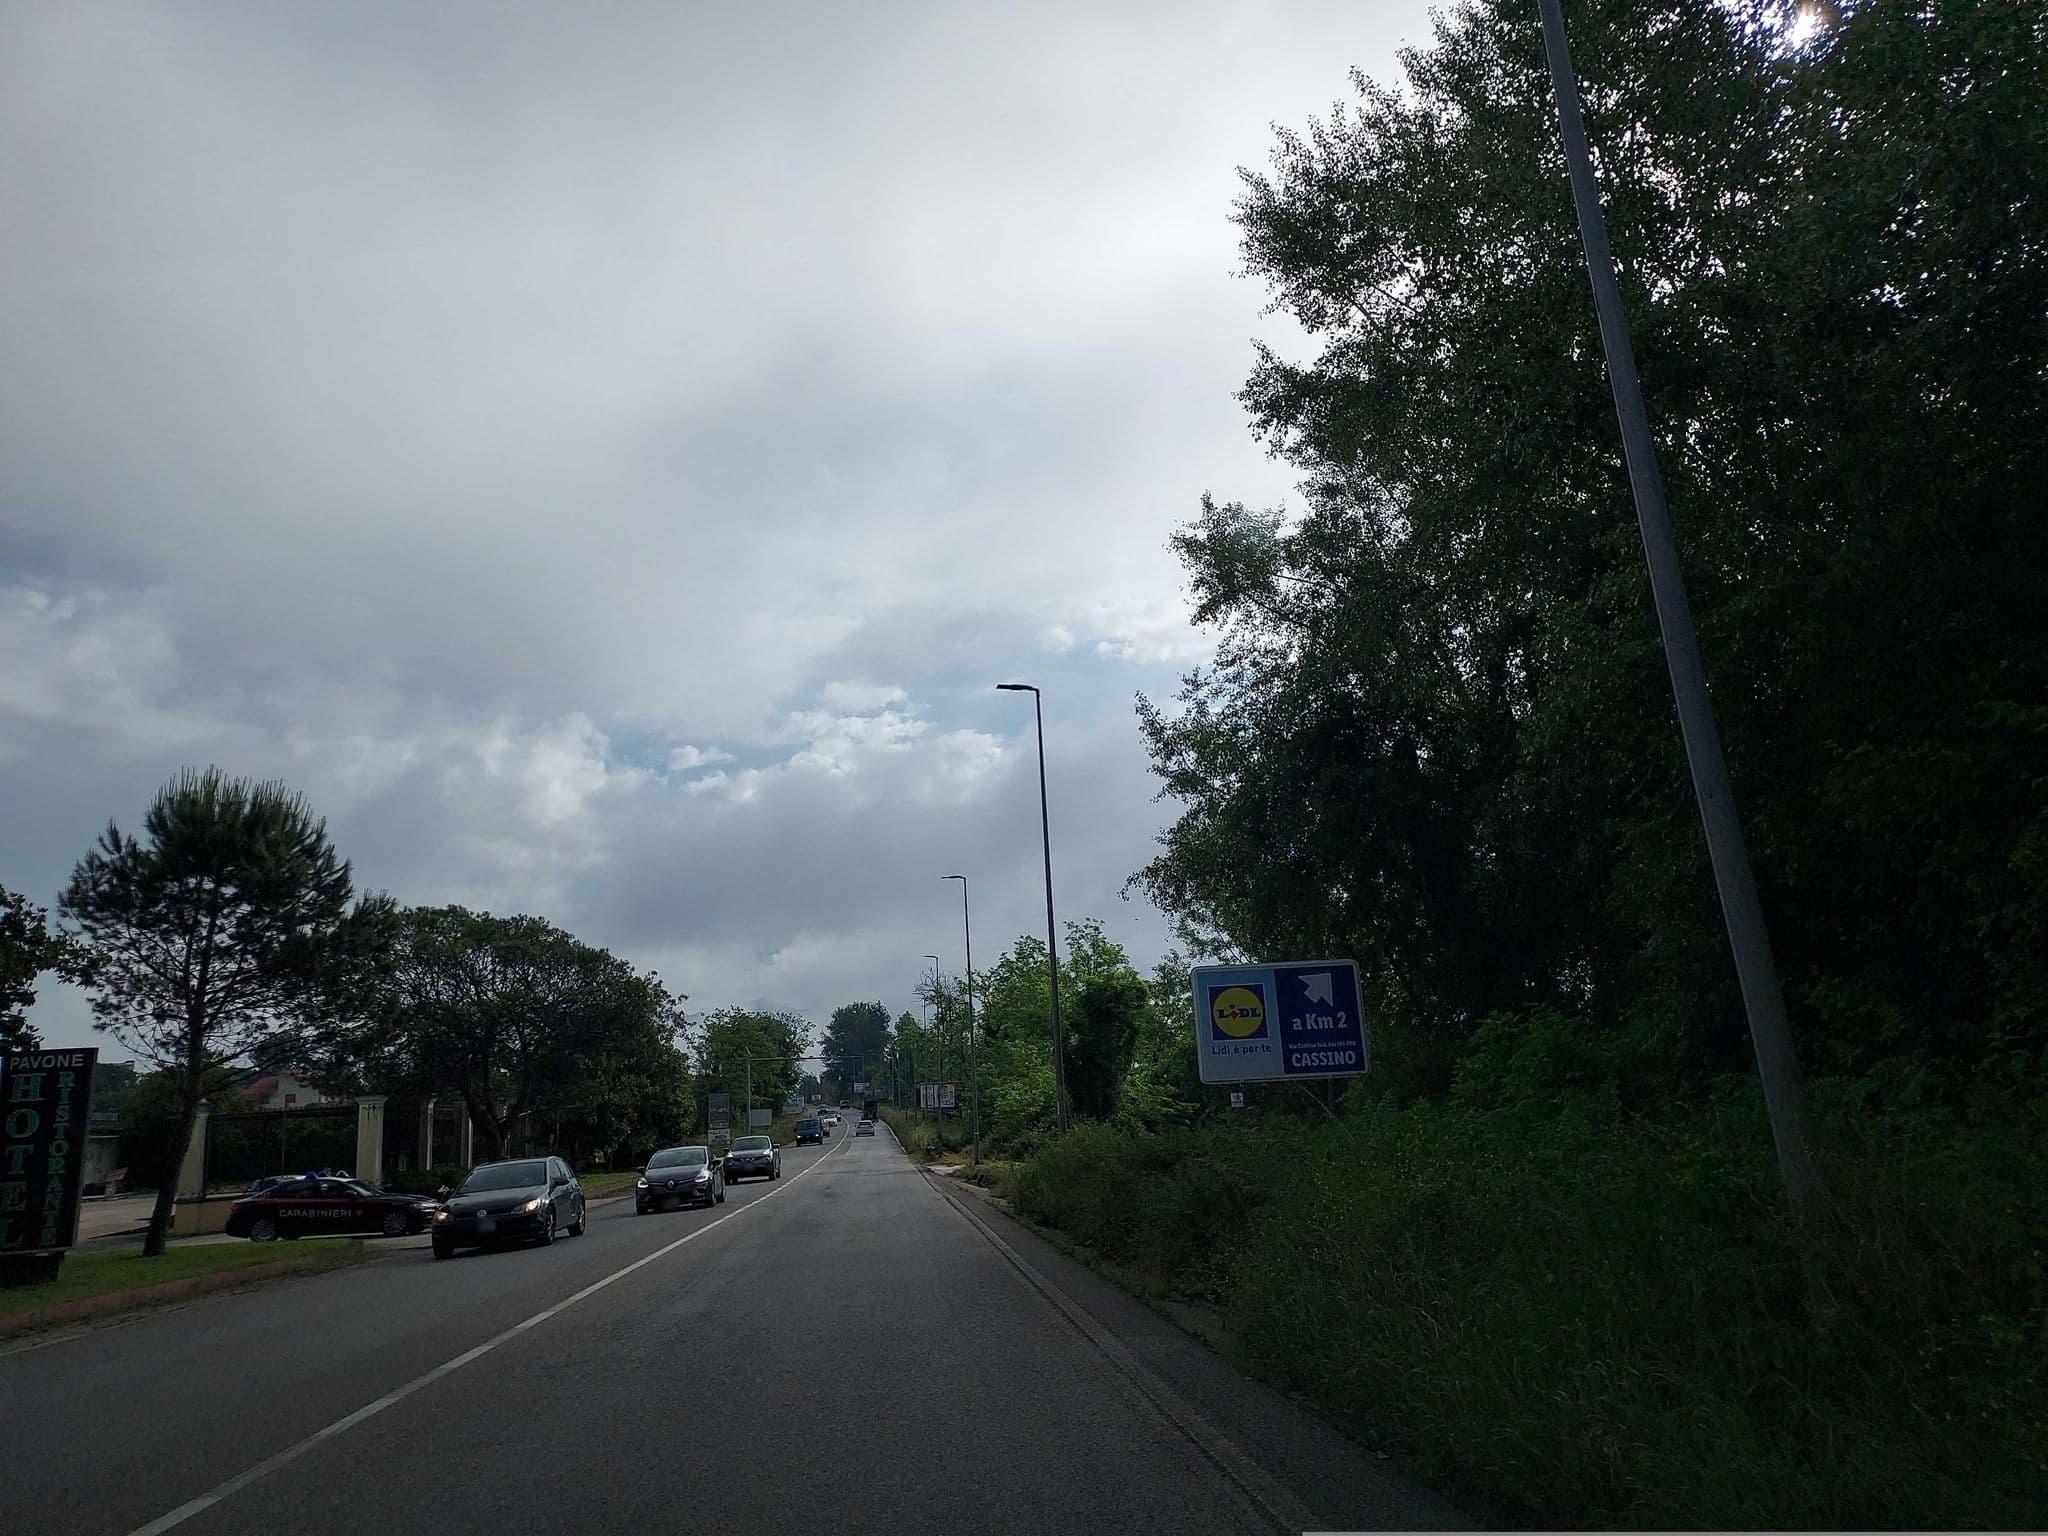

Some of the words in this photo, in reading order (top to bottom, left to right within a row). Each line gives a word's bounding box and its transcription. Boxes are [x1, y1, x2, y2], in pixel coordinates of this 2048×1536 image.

[1292, 1018, 1302, 1030] a
[1306, 1014, 1334, 1029] Km
[1337, 1011, 1347, 1028] 2
[1212, 1044, 1230, 1056] Lidl
[1234, 1045, 1239, 1053] è
[1243, 1046, 1259, 1056] per
[1262, 1044, 1272, 1053] te
[1292, 1050, 1356, 1067] CASSINO
[10, 1053, 84, 1070] PAVONE
[0, 1072, 47, 1249] HOTEL
[279, 1209, 352, 1217] CARABINIERI
